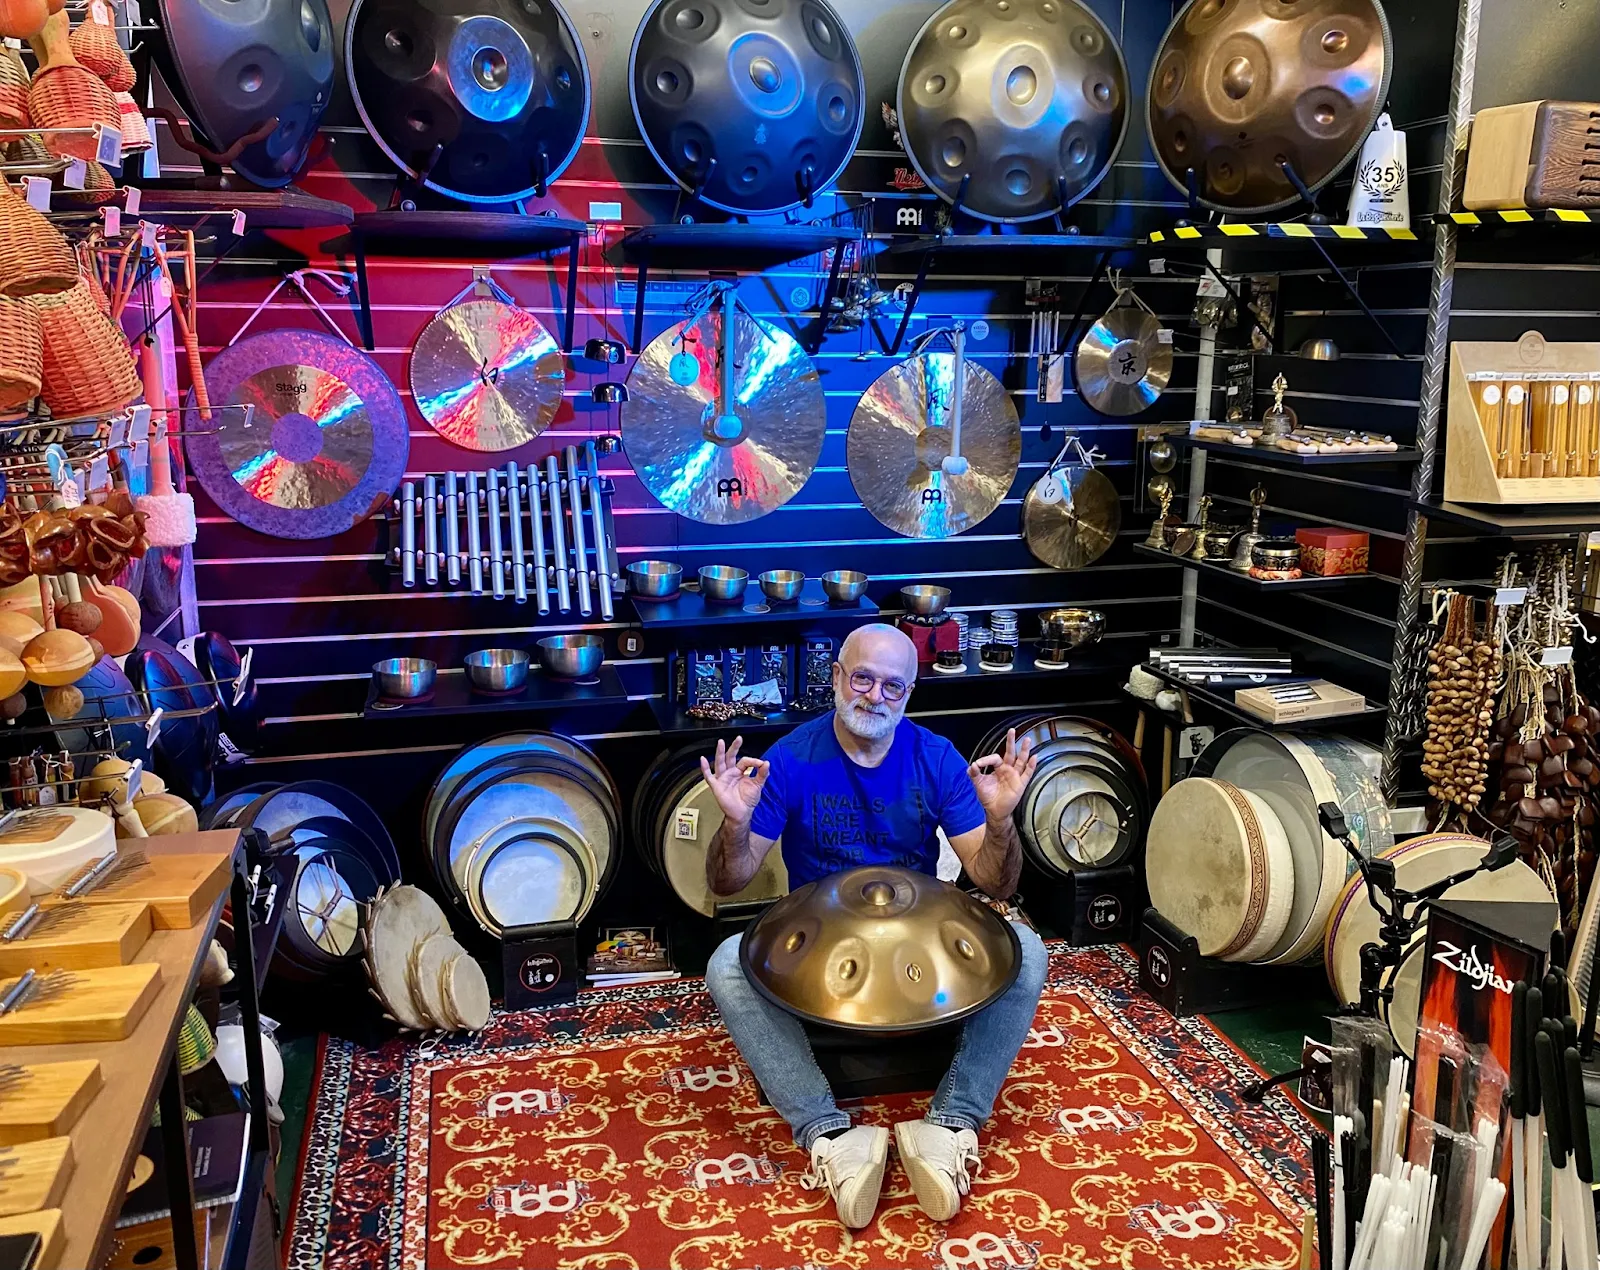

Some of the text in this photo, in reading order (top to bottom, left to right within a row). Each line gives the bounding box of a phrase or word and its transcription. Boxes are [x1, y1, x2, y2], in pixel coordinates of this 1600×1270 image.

[1372, 167, 1394, 183] 35
[276, 383, 307, 395] Stagg
[820, 793, 886, 814] WALS
[820, 812, 860, 828] ARE
[821, 830, 890, 846] MEANT
[1137, 1211, 1164, 1244] MEINL
